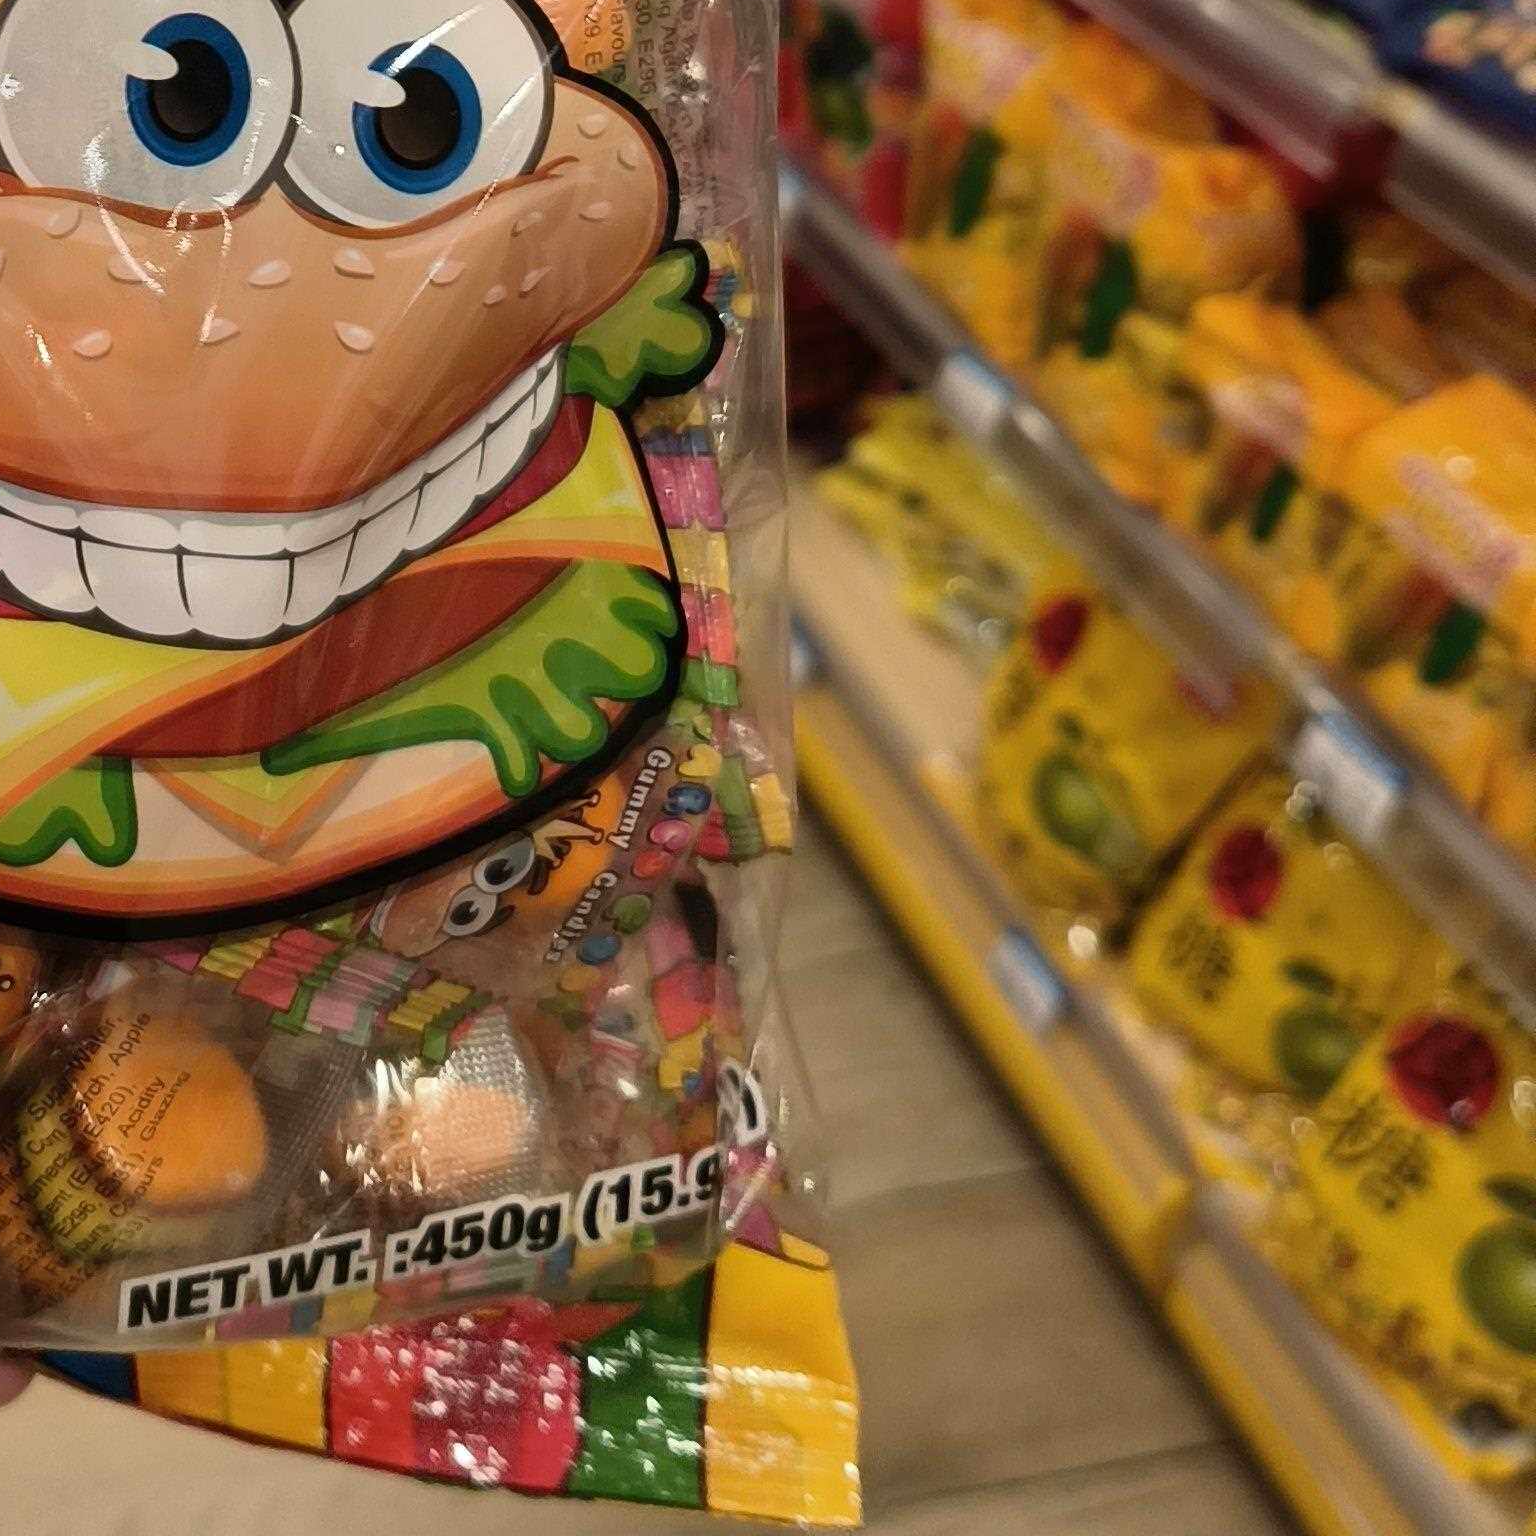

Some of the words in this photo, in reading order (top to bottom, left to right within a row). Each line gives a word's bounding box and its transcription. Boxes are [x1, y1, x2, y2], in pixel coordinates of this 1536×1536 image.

[607, 746, 674, 852] Gummy
[125, 1267, 253, 1330] NET
[263, 1238, 368, 1303] WT.
[392, 1193, 564, 1276] :450g
